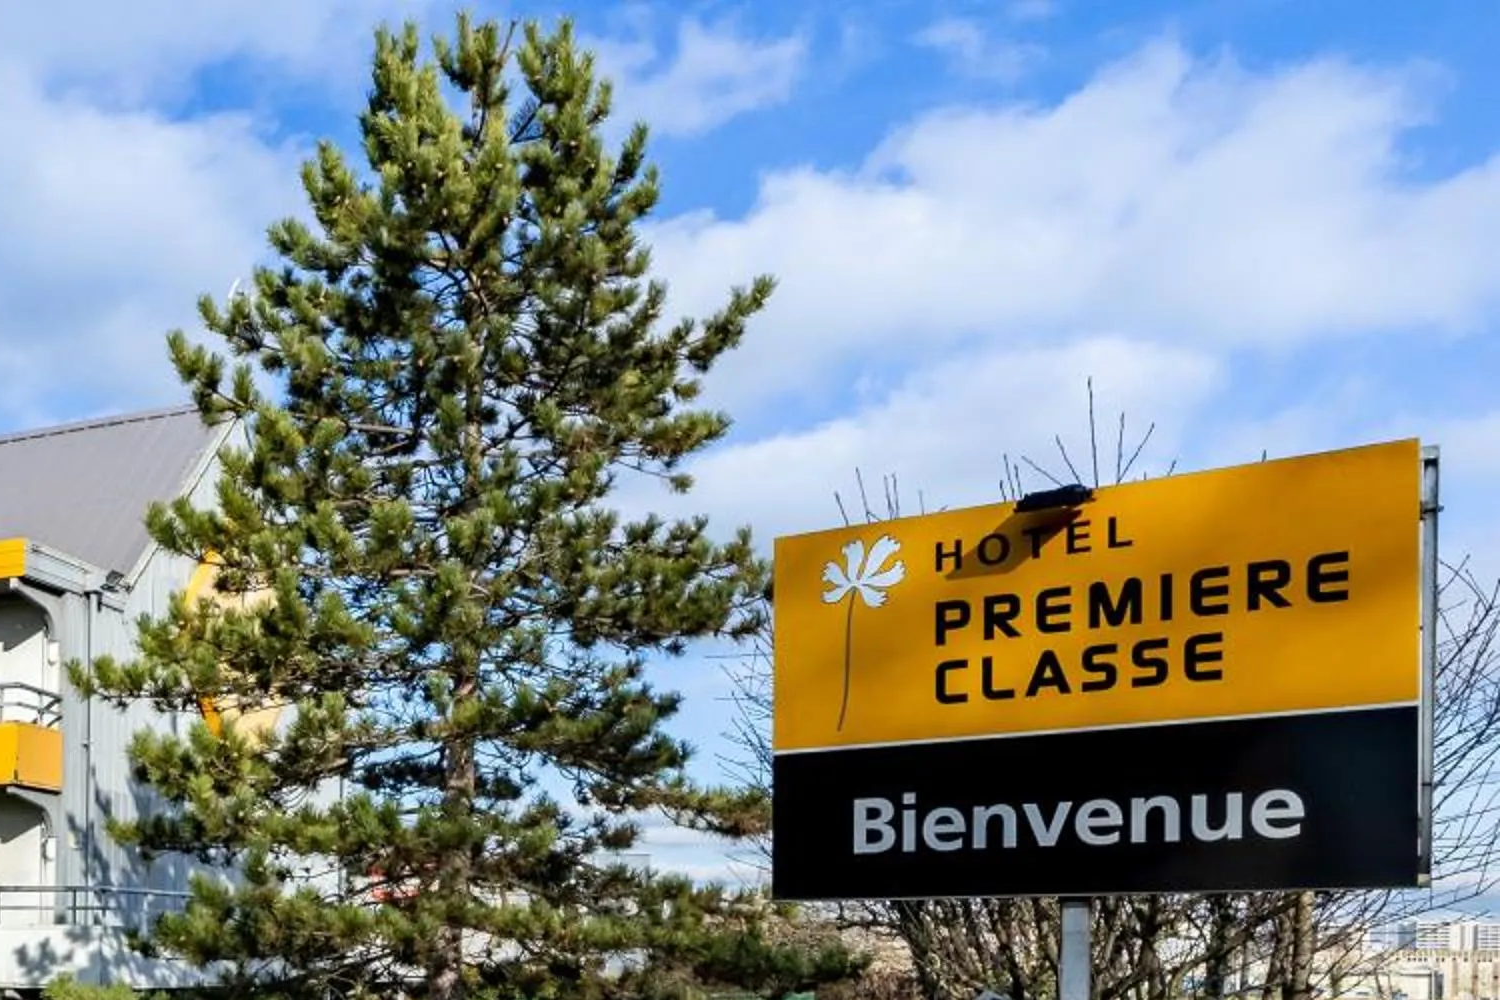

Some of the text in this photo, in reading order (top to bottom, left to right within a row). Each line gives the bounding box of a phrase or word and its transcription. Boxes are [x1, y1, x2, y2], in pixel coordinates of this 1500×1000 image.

[936, 516, 1133, 572] HOTEL
[936, 551, 1350, 645] PREMIERE
[936, 632, 1223, 704] CLASSE
[853, 789, 1305, 855] Bienvenue
